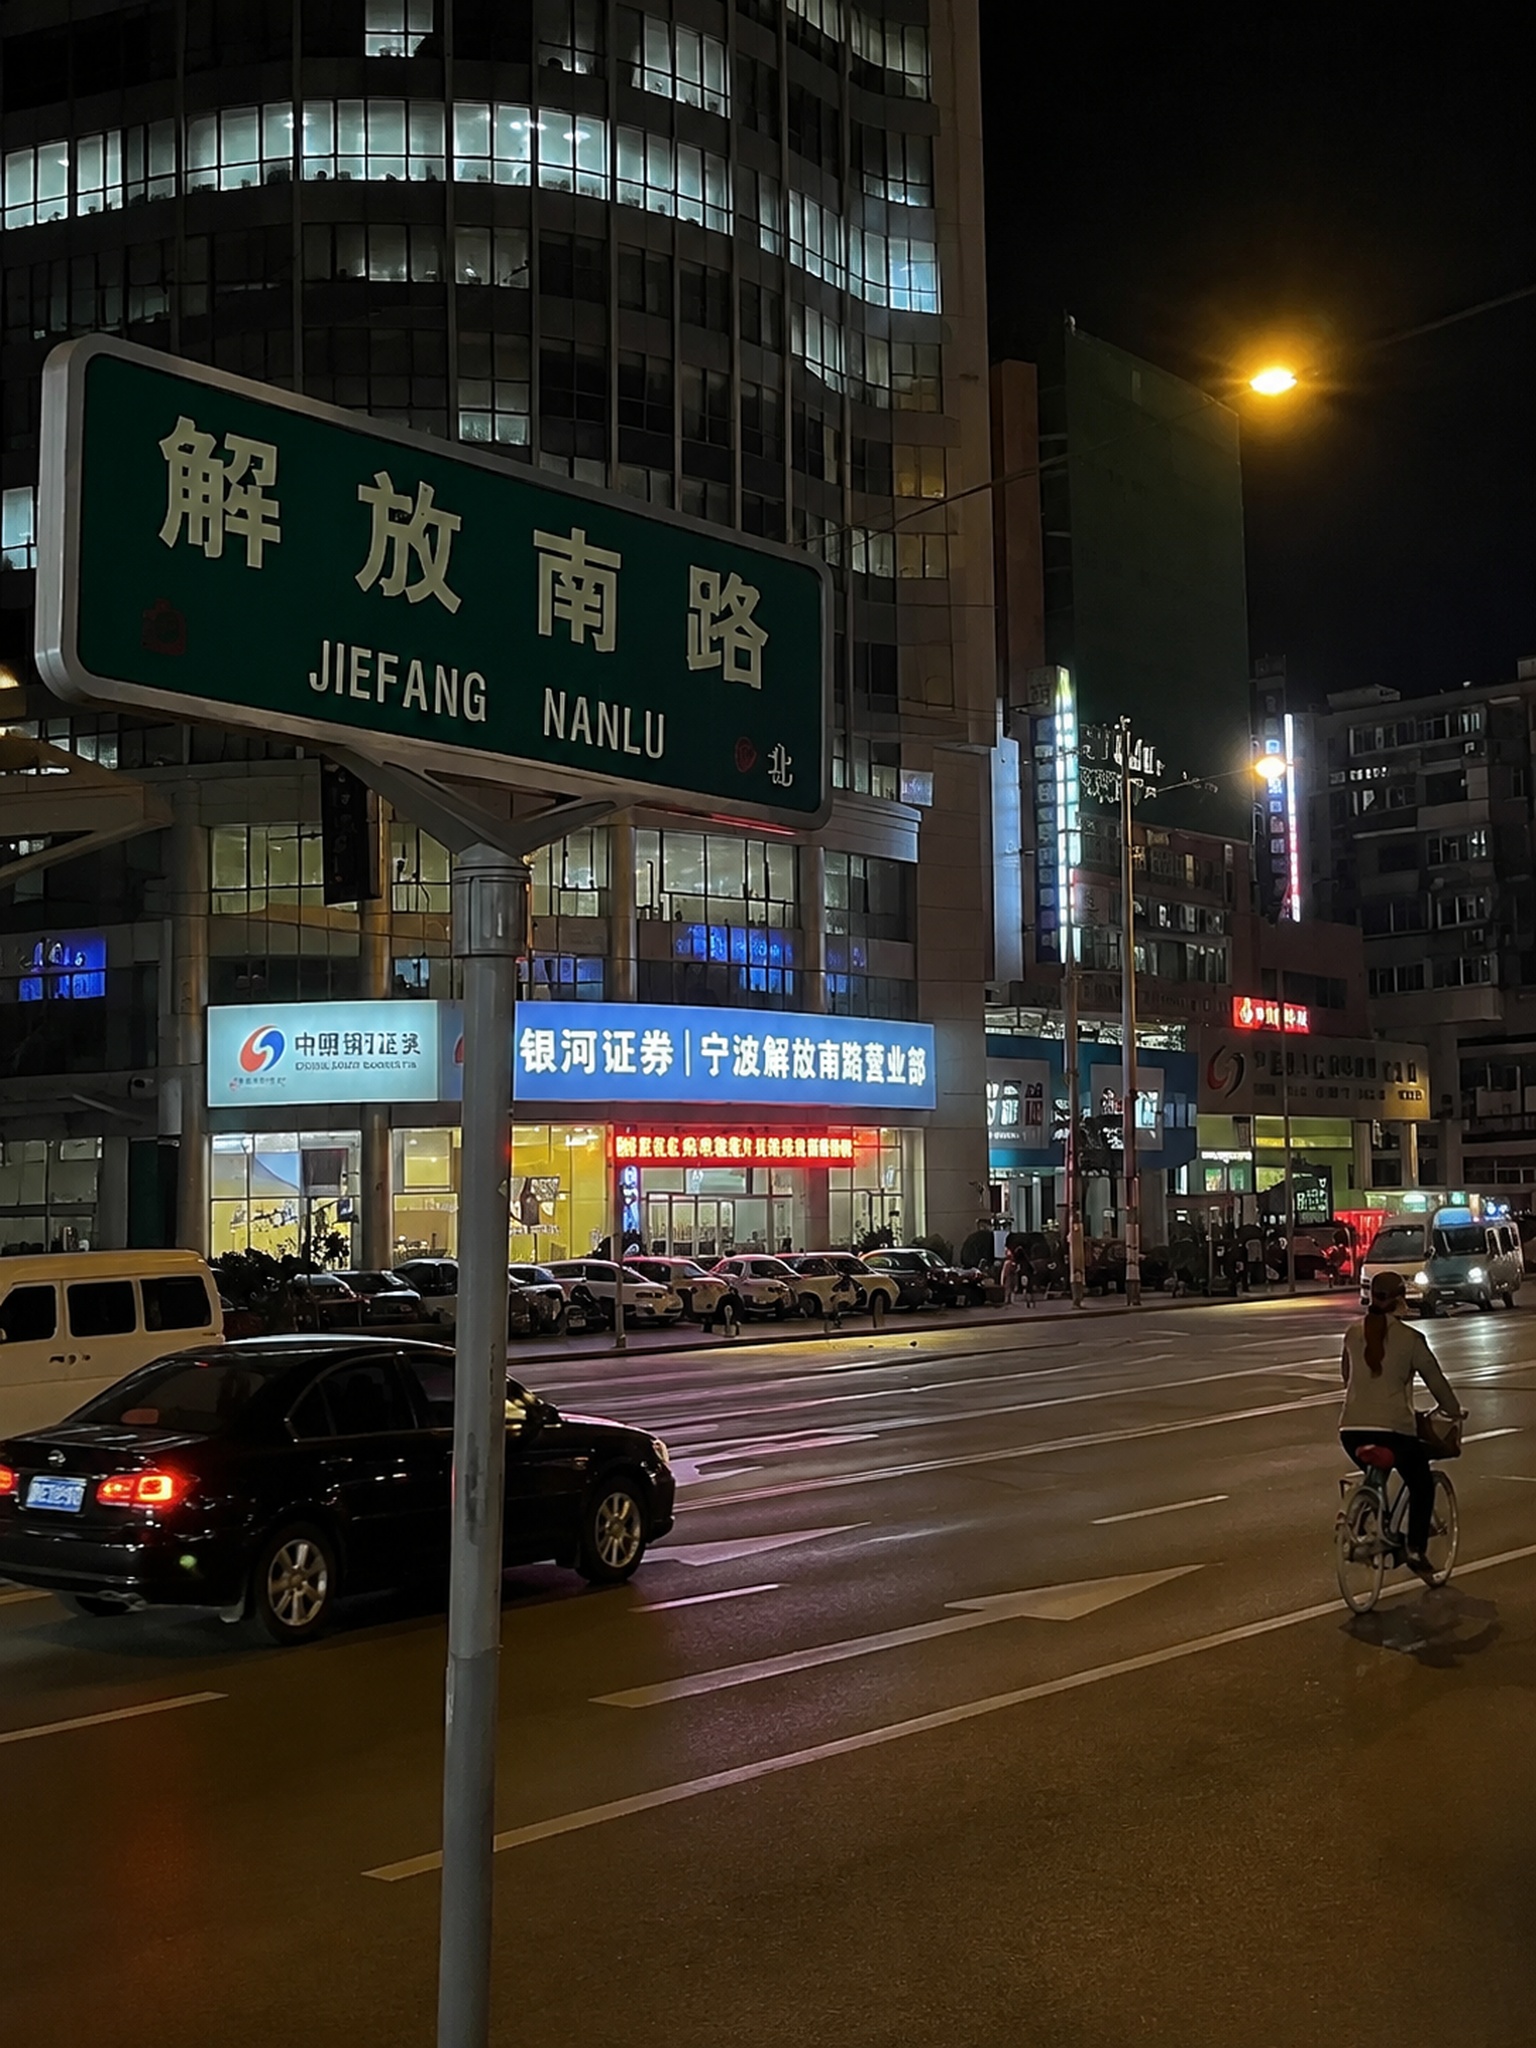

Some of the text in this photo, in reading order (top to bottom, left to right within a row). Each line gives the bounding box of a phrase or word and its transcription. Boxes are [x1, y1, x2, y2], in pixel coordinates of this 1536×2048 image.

[158, 415, 769, 690] 解放南路
[309, 639, 666, 760] JIEFANG NANLU
[519, 1027, 926, 1087] 银河证券 宁波解放南路营业部
